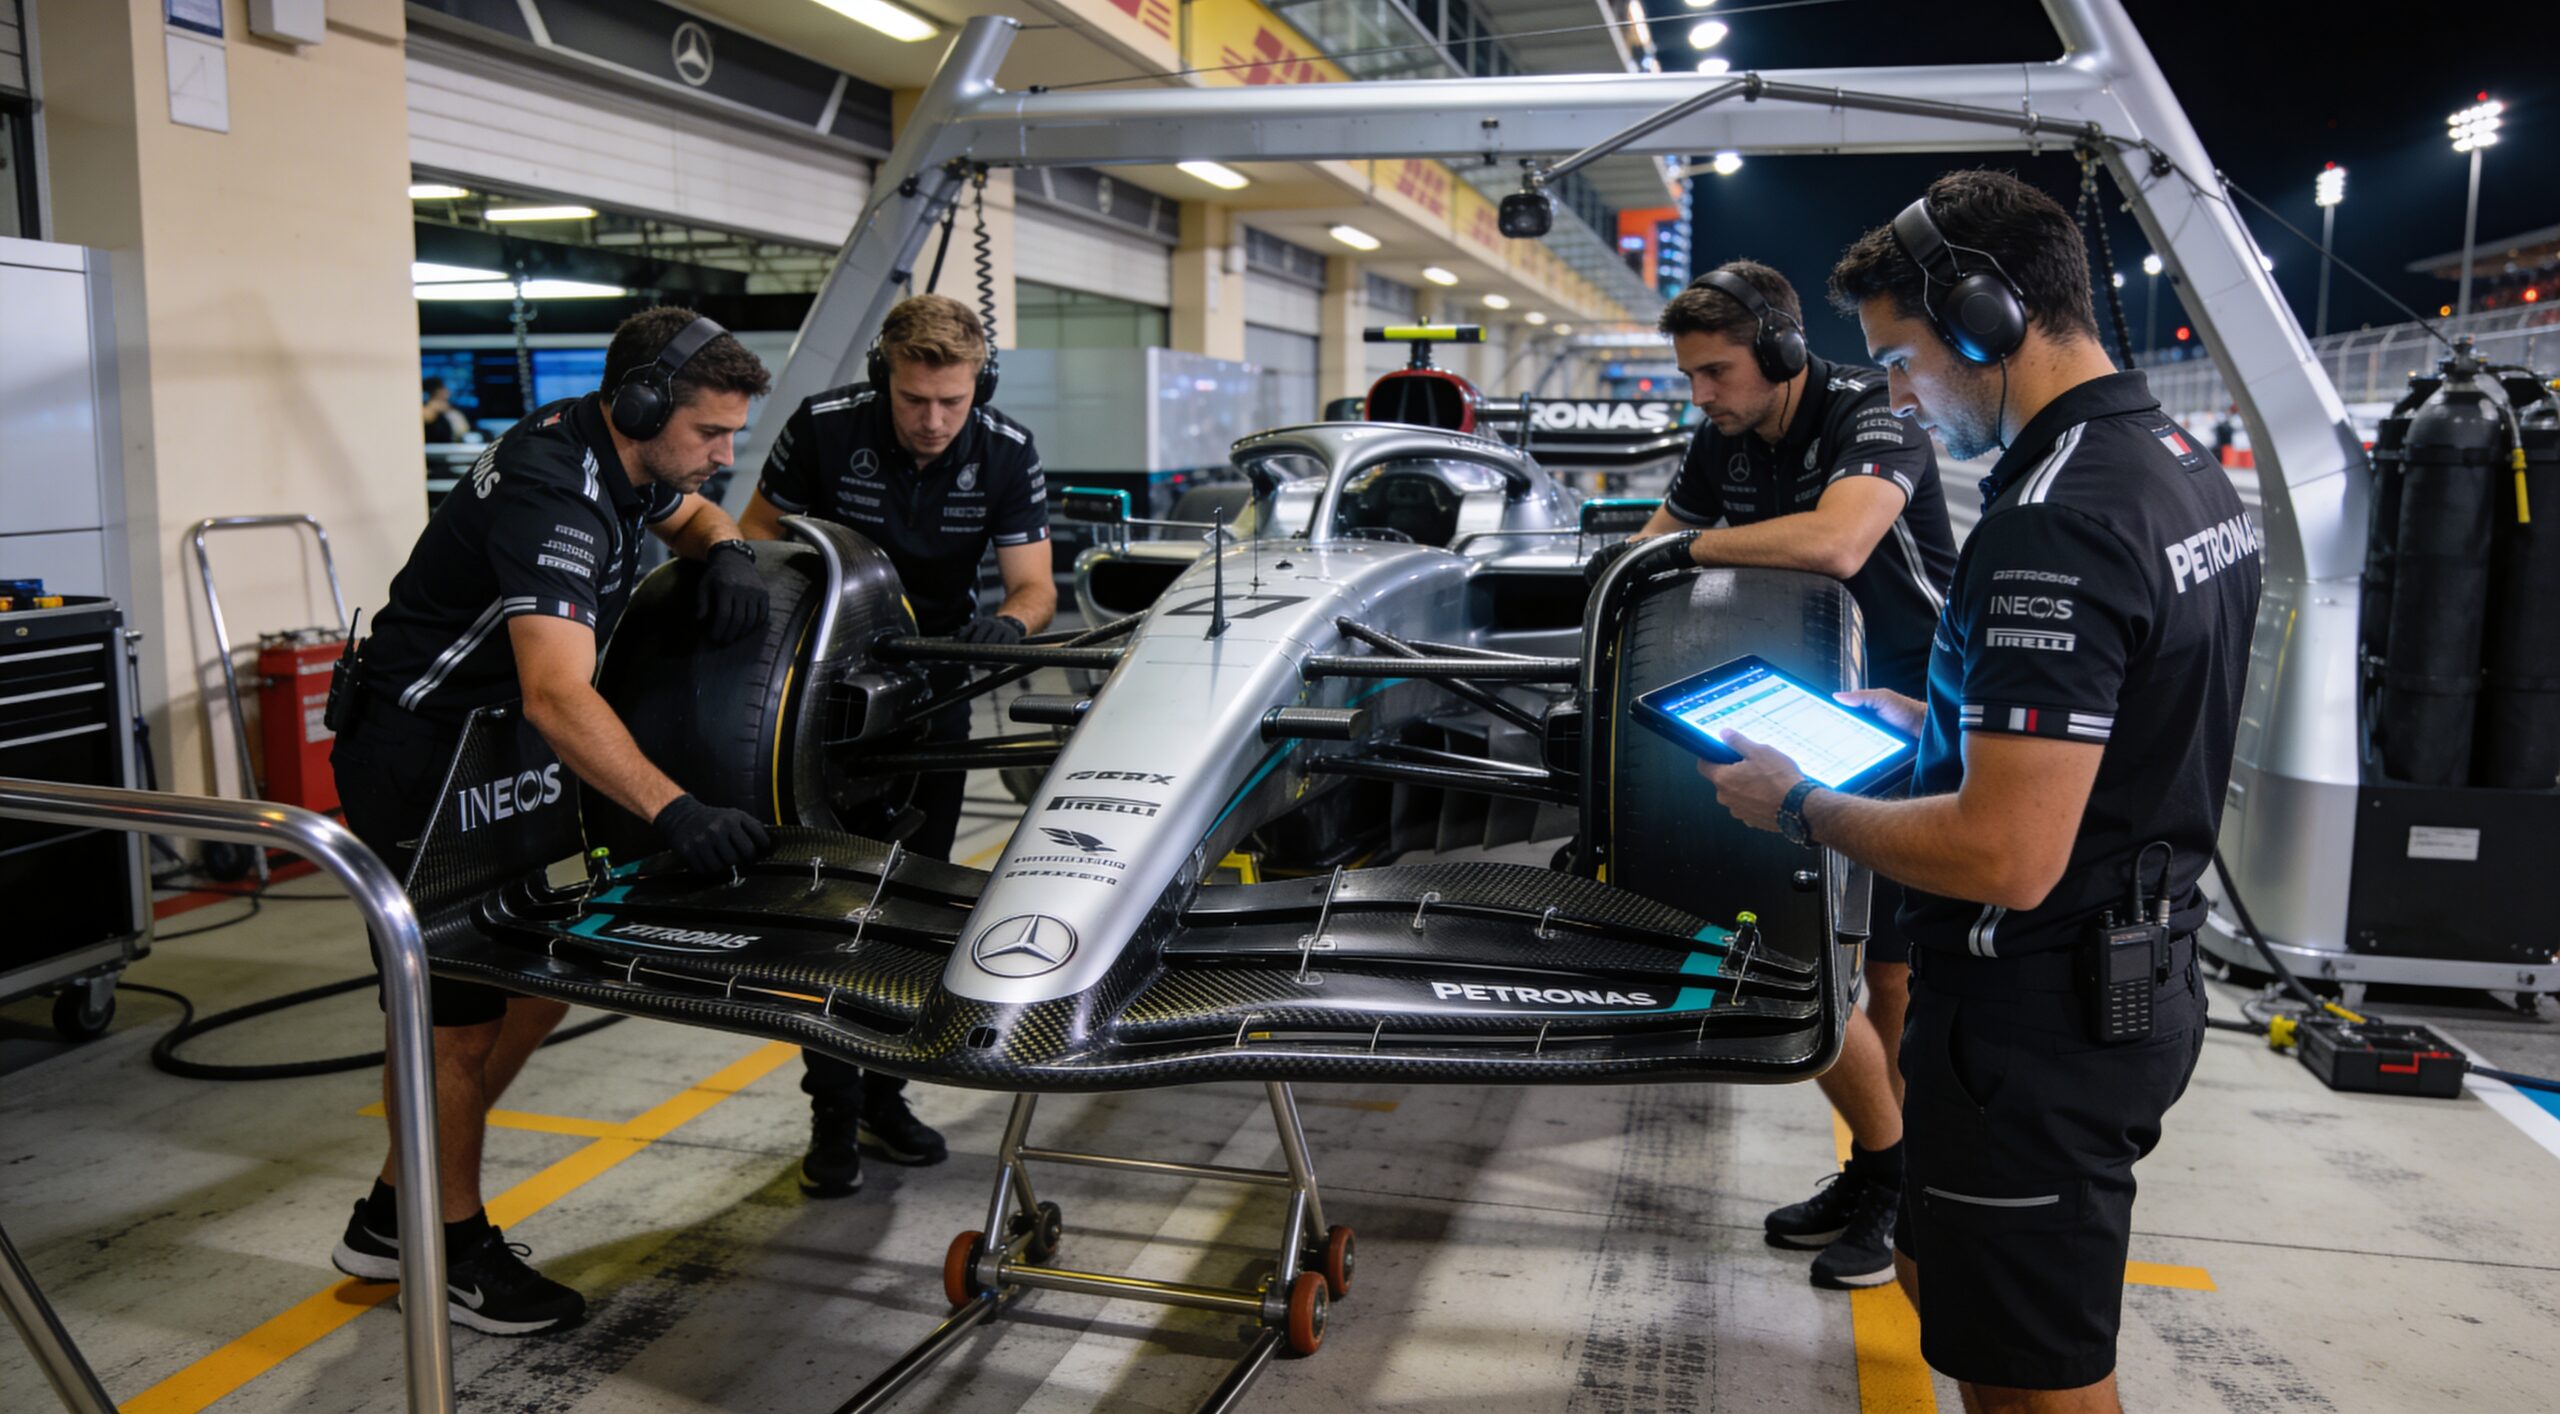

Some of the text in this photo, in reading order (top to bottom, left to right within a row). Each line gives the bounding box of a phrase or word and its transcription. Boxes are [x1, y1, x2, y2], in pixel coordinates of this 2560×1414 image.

[1989, 595, 2074, 620] INEOS
[1986, 628, 2076, 652] PIRELLI
[458, 762, 562, 832] INEOS
[1046, 796, 1162, 818] PIRELLI
[1431, 981, 1658, 1006] PETRONAS
